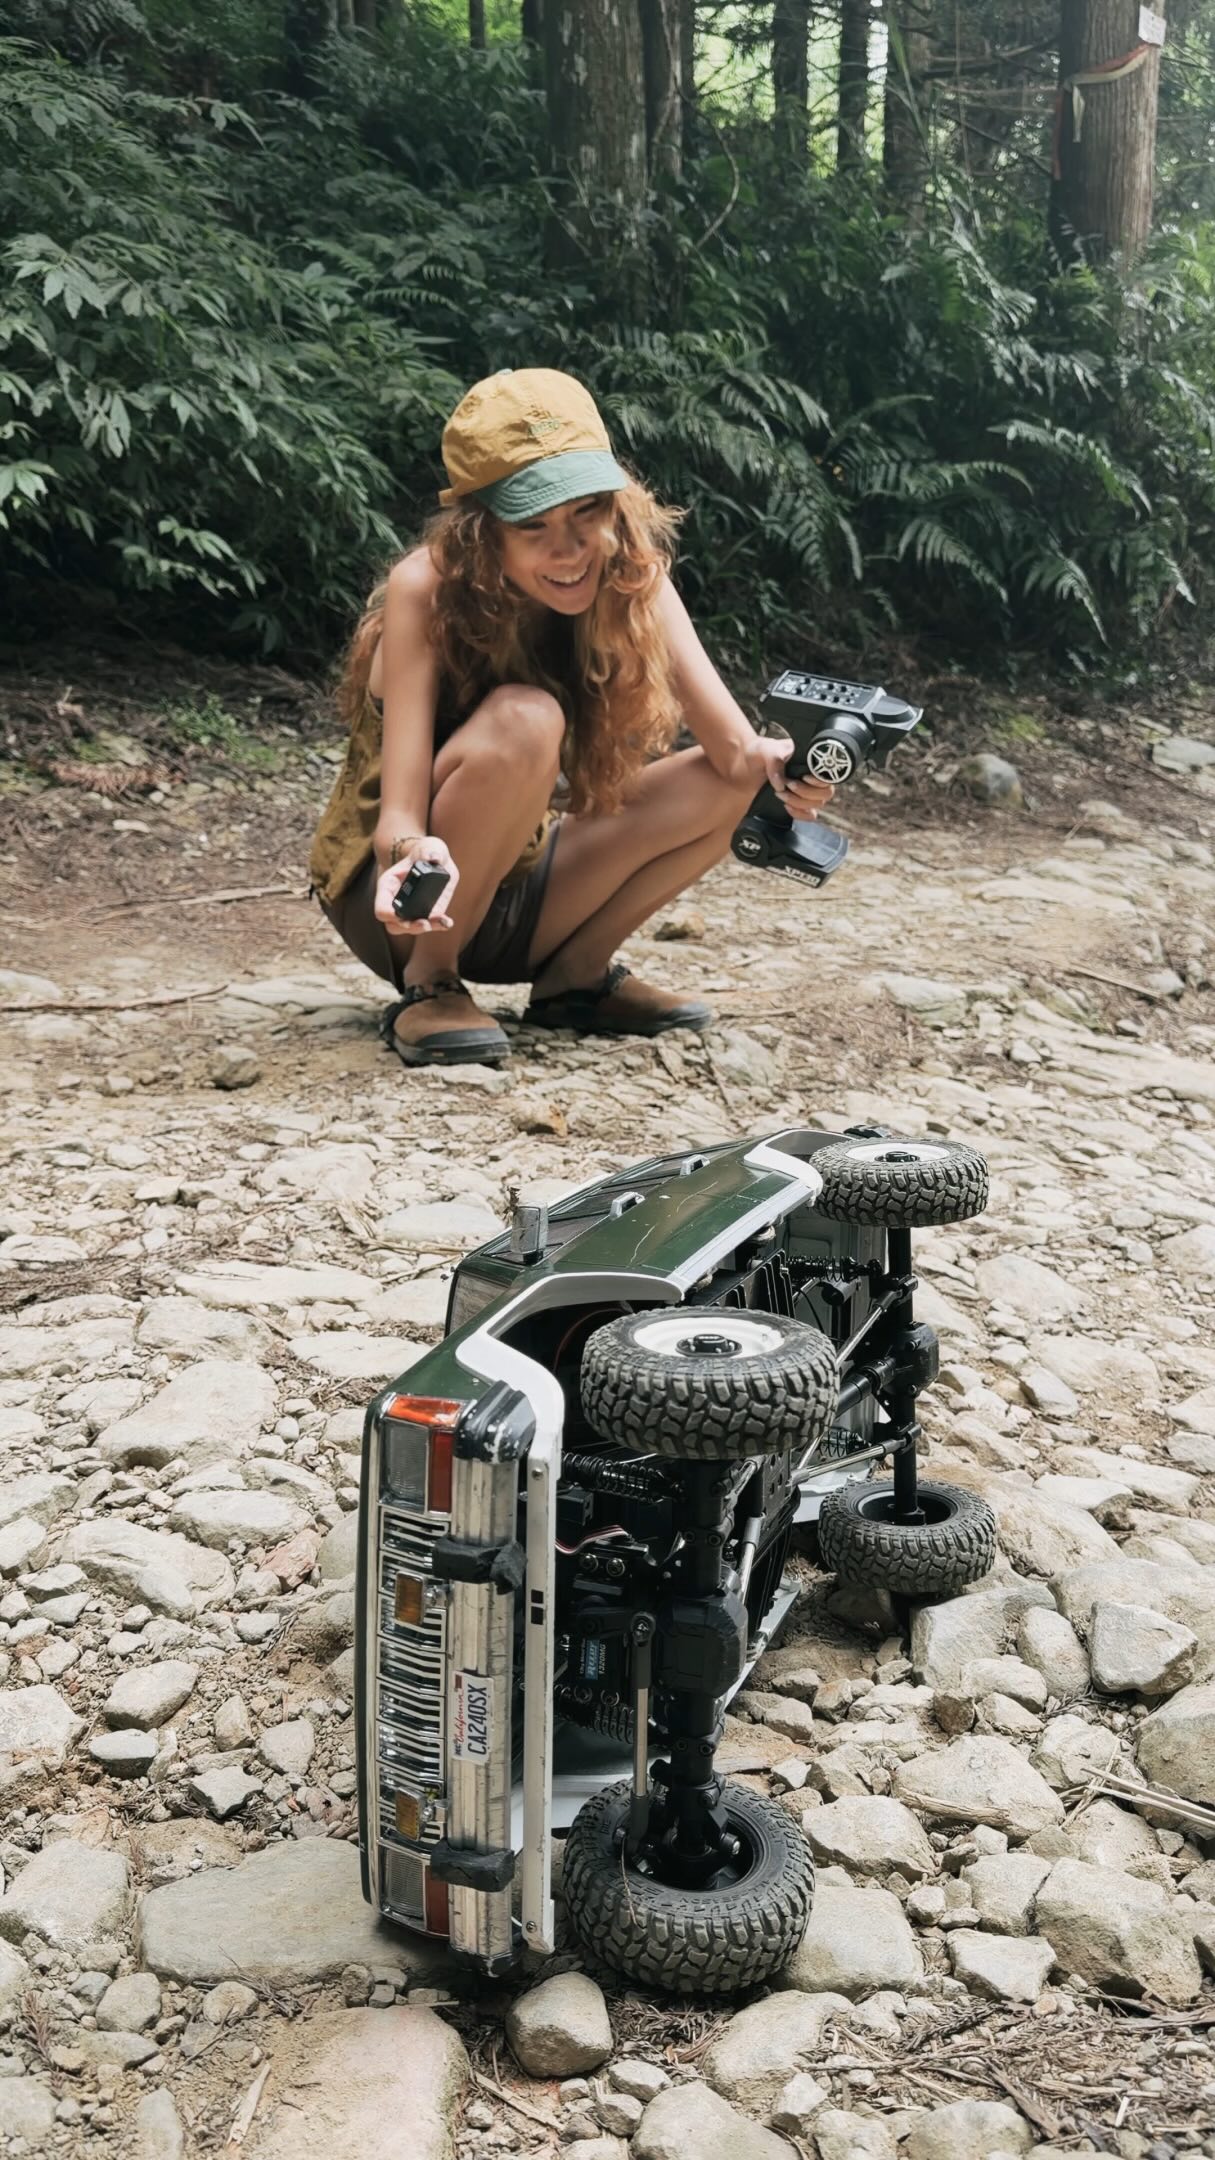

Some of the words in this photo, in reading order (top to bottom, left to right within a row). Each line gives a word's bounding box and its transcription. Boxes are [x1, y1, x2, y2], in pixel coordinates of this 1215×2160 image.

[738, 839, 761, 851] XP
[455, 1692, 466, 1744] California
[467, 1683, 487, 1755] CA240SX
